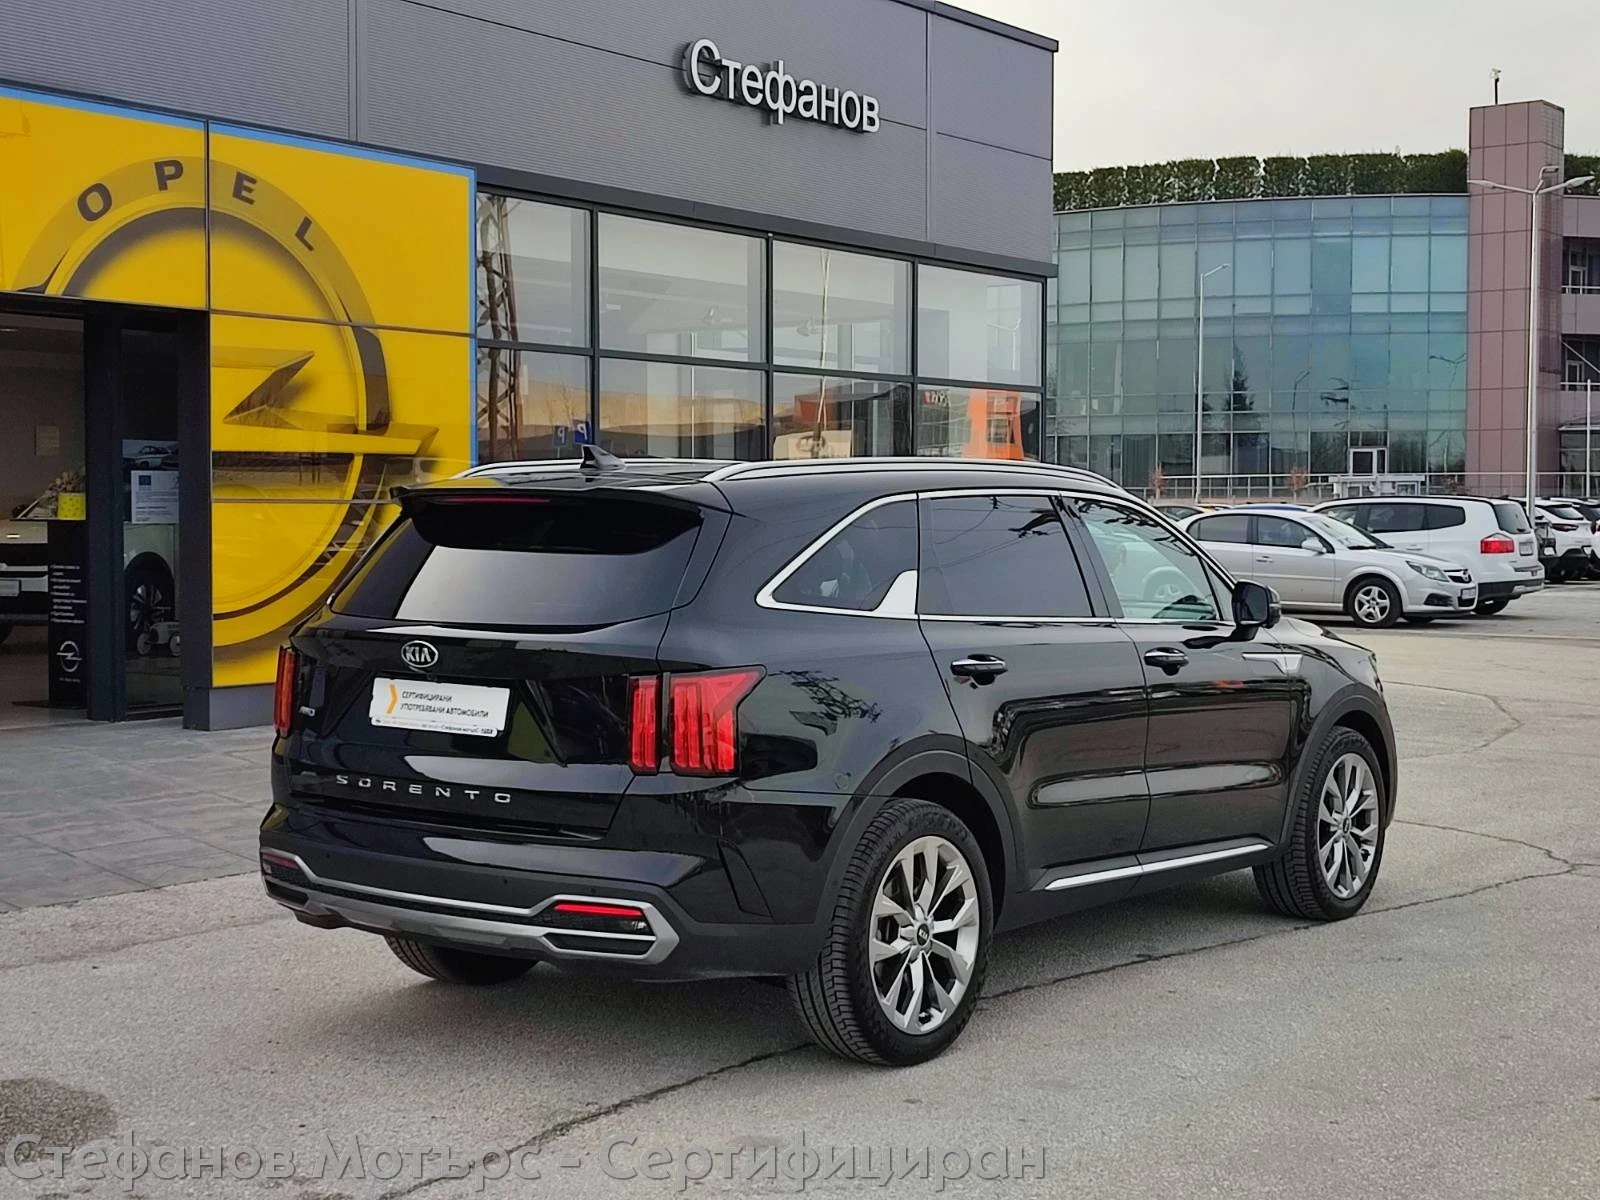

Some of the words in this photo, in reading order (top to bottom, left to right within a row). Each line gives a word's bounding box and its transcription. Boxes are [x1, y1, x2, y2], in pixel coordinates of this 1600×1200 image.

[685, 38, 880, 133] Стефанов
[77, 158, 315, 252] OPEL
[405, 646, 432, 662] KIA
[336, 774, 511, 803] SORENTO
